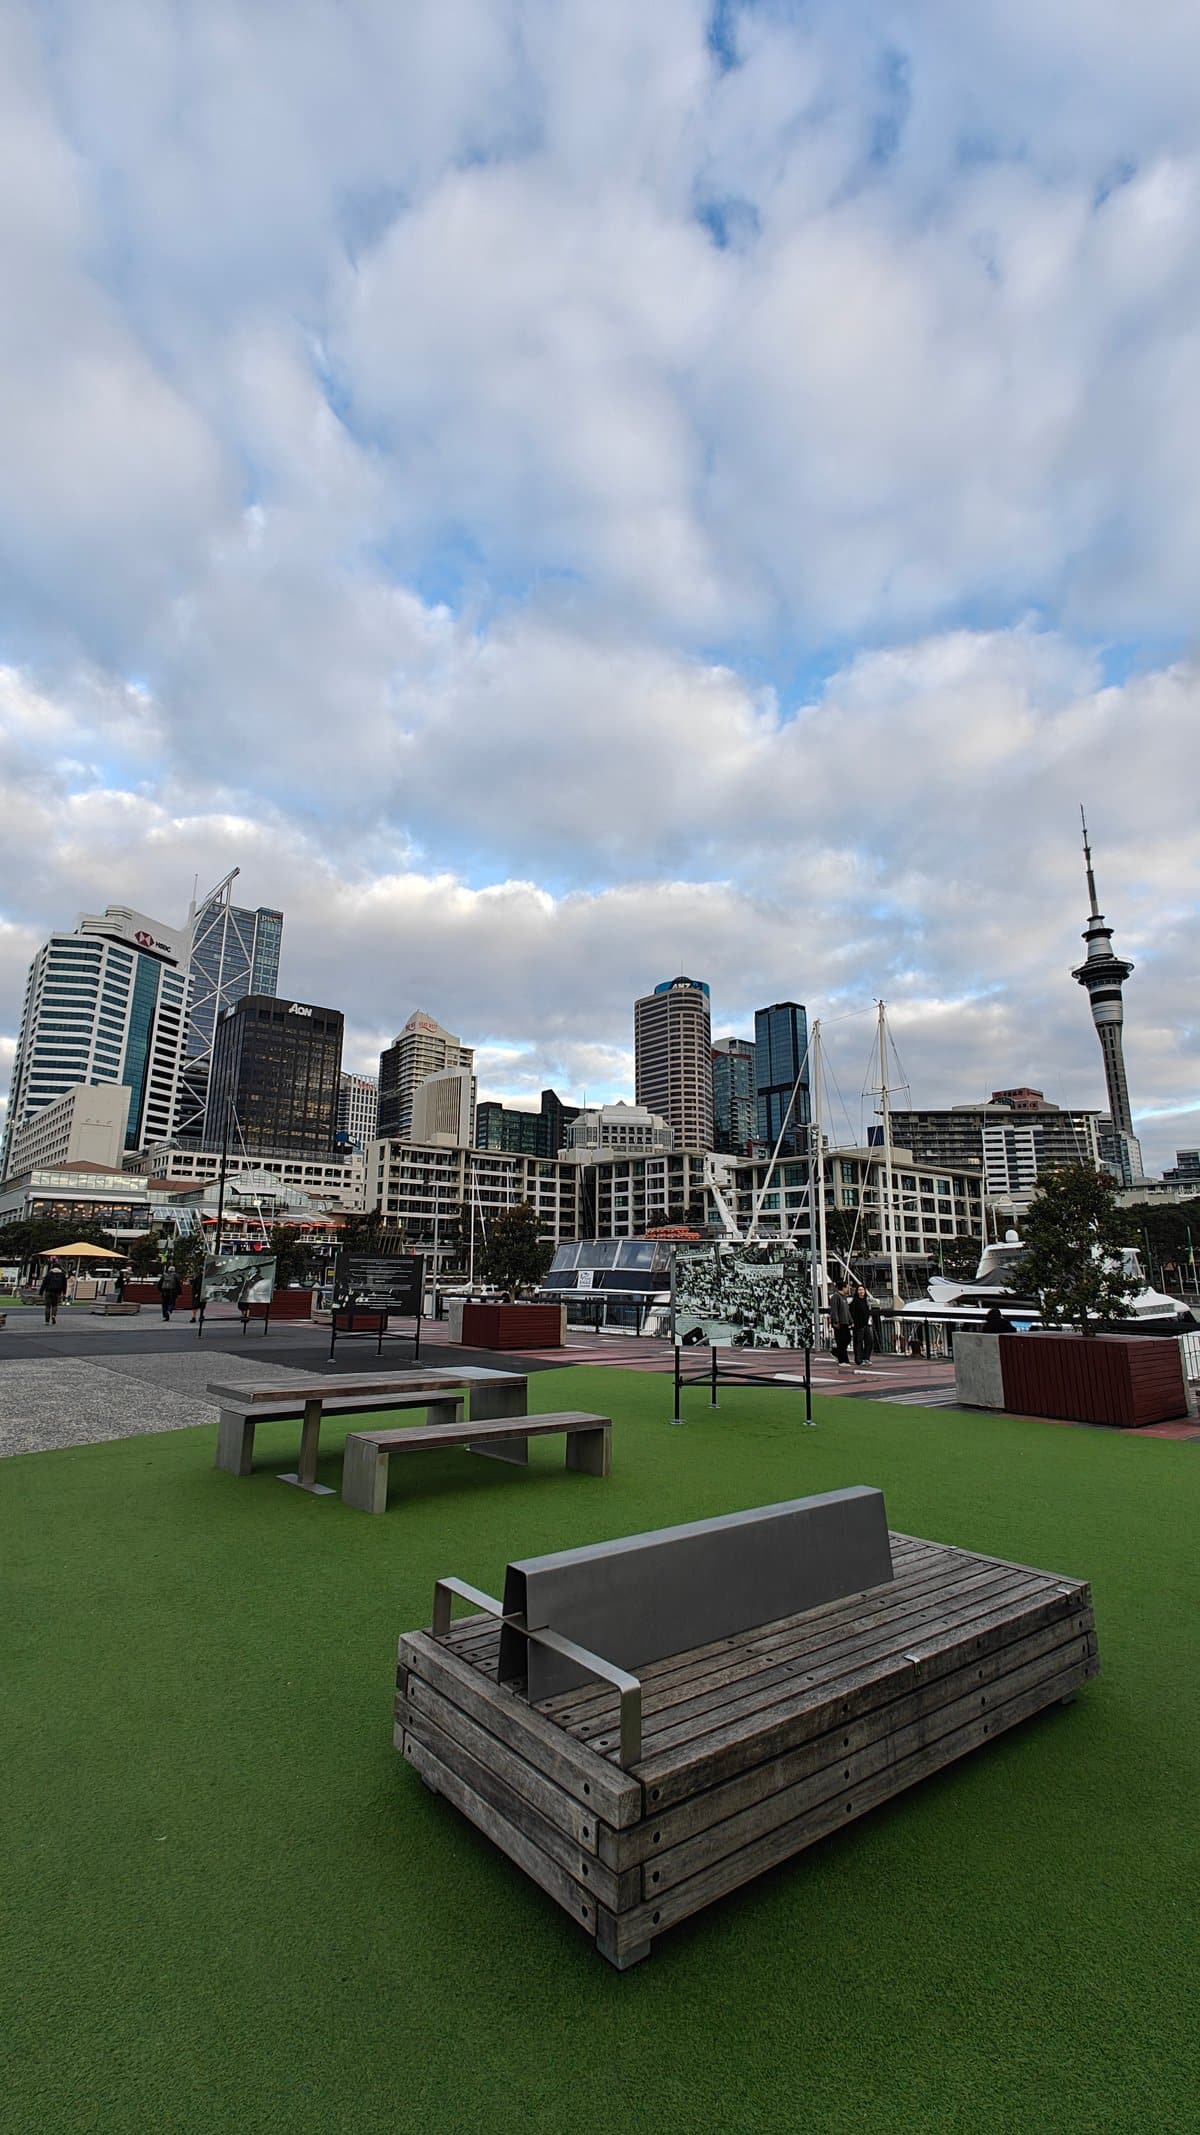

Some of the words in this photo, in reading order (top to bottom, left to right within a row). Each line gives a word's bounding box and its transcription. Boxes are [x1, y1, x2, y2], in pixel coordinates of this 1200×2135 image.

[261, 914, 282, 925] pc
[672, 983, 691, 991] ANZ
[288, 1003, 313, 1017] AON
